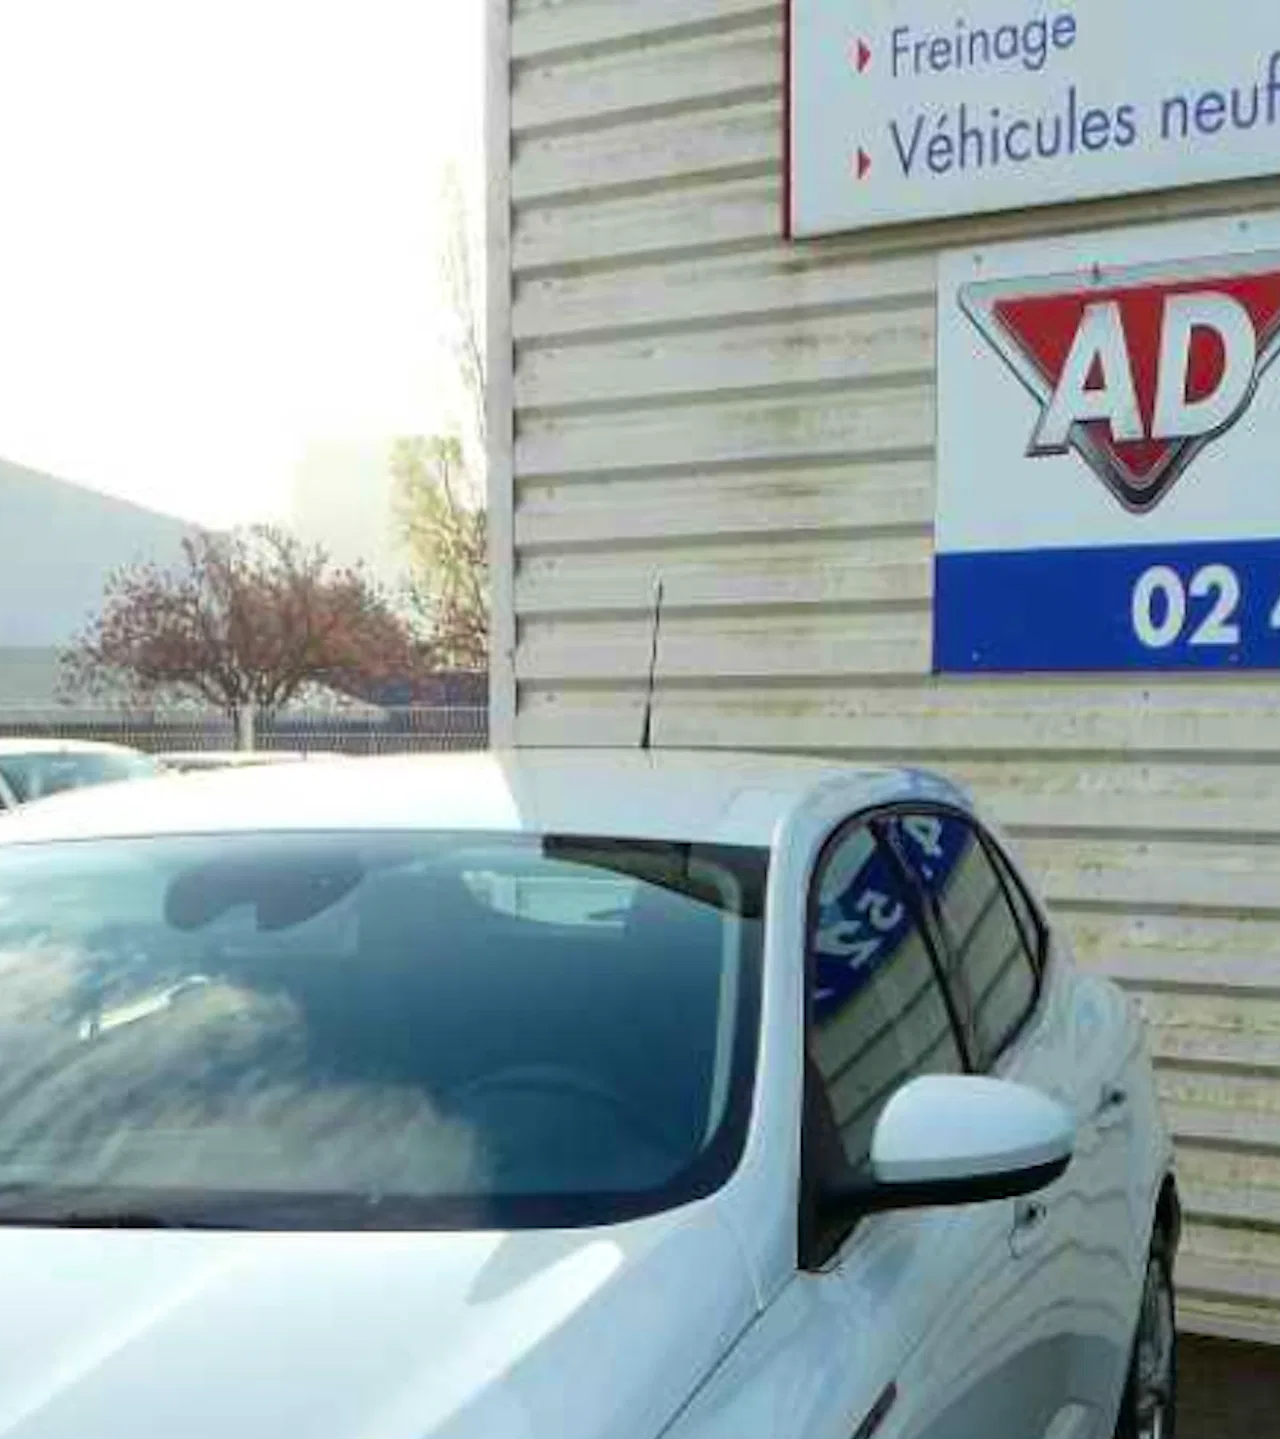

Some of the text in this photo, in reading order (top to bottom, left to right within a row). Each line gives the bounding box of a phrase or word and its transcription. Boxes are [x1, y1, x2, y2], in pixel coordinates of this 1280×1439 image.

[890, 13, 1077, 77] Freinage
[889, 85, 1137, 178] Véhicules
[1028, 290, 1258, 457] AD
[1132, 563, 1241, 649] 02
